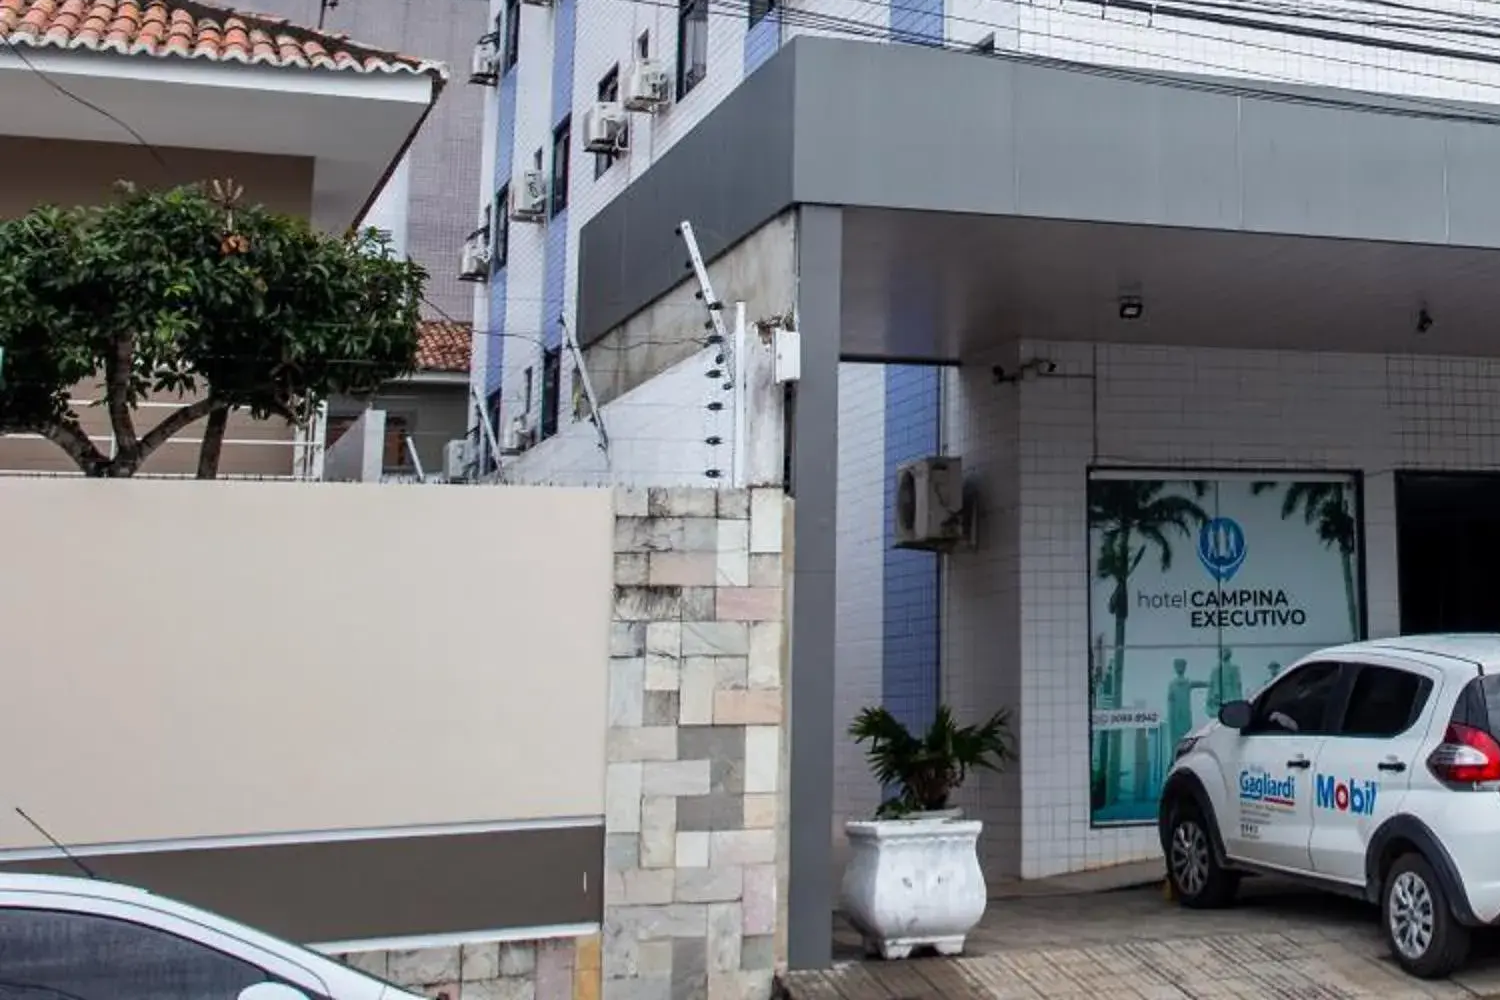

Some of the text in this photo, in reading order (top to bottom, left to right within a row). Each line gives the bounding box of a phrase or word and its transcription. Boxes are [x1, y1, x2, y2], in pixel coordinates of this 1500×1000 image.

[1137, 588, 1289, 610] hotel CAMPINA
[1190, 608, 1306, 629] EXECUTIVO
[1239, 770, 1296, 800] Gagliardi
[1316, 773, 1377, 816] Mobil
